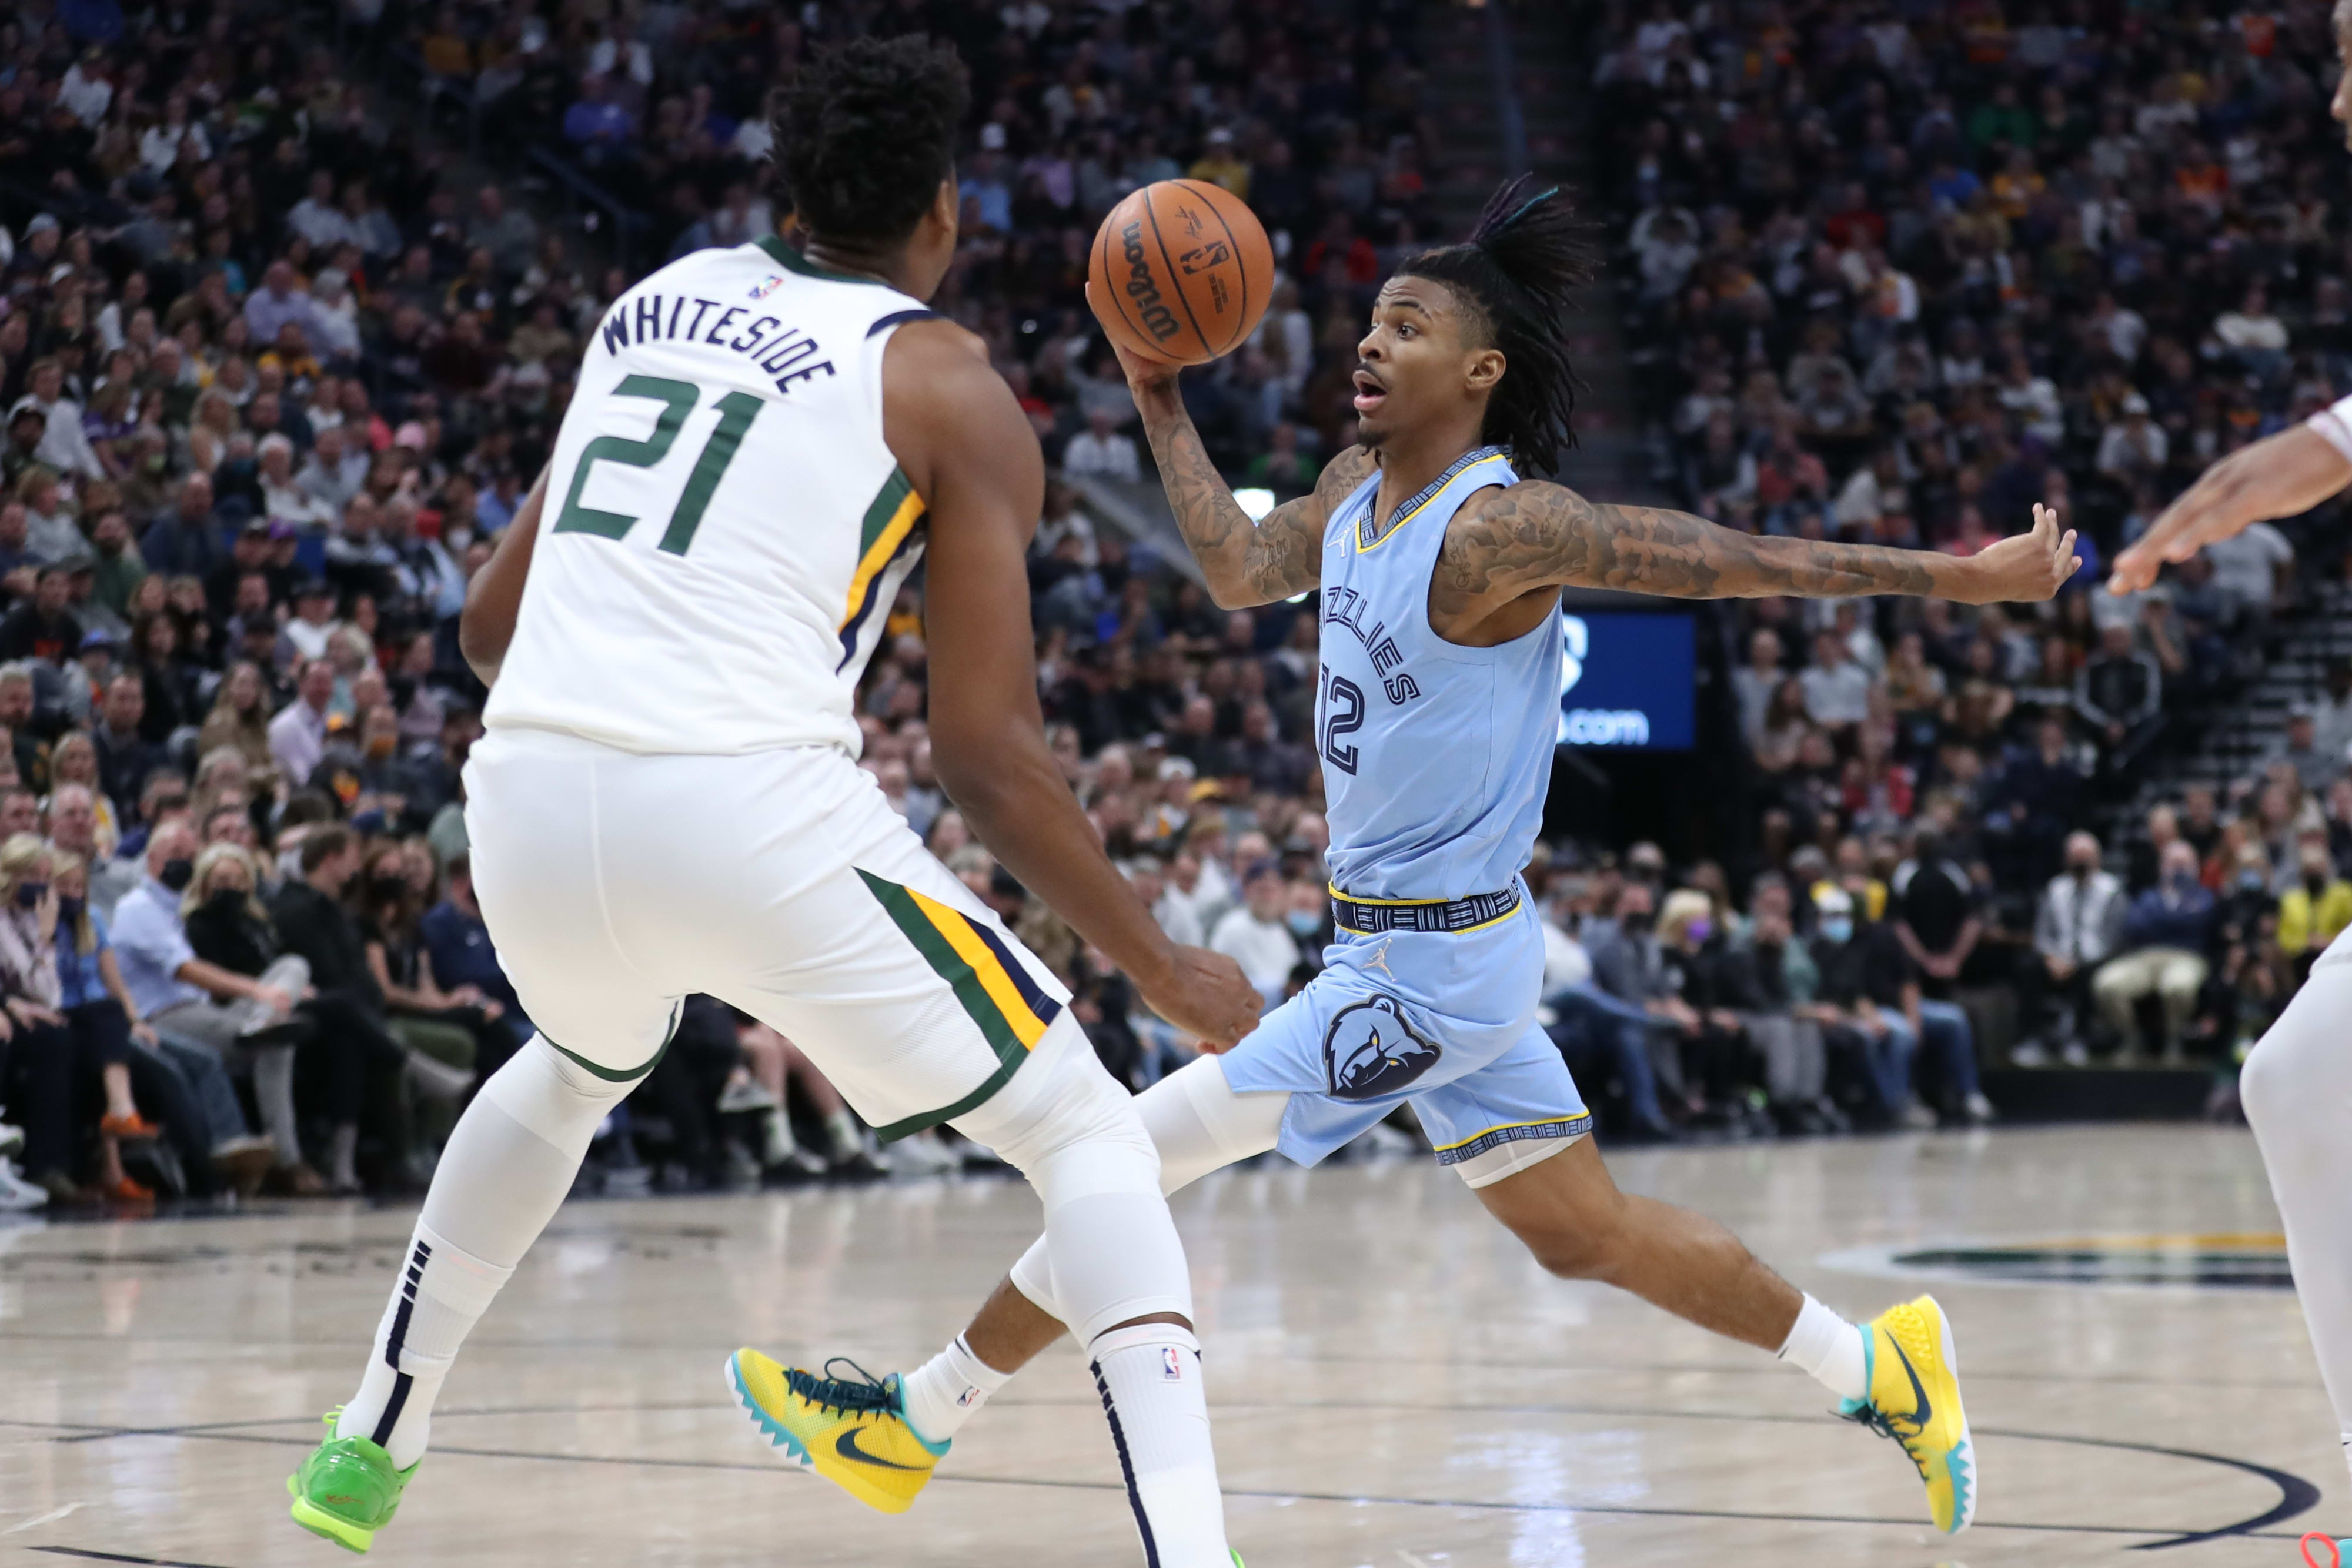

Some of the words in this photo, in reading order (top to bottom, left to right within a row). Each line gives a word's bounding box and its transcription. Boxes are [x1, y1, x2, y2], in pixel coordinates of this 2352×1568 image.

[1122, 219, 1181, 343] Wilson
[603, 295, 836, 394] WHITESIDE
[552, 373, 766, 557] 21
[1319, 586, 1421, 706] IZZLIES
[1319, 662, 1365, 776] 12
